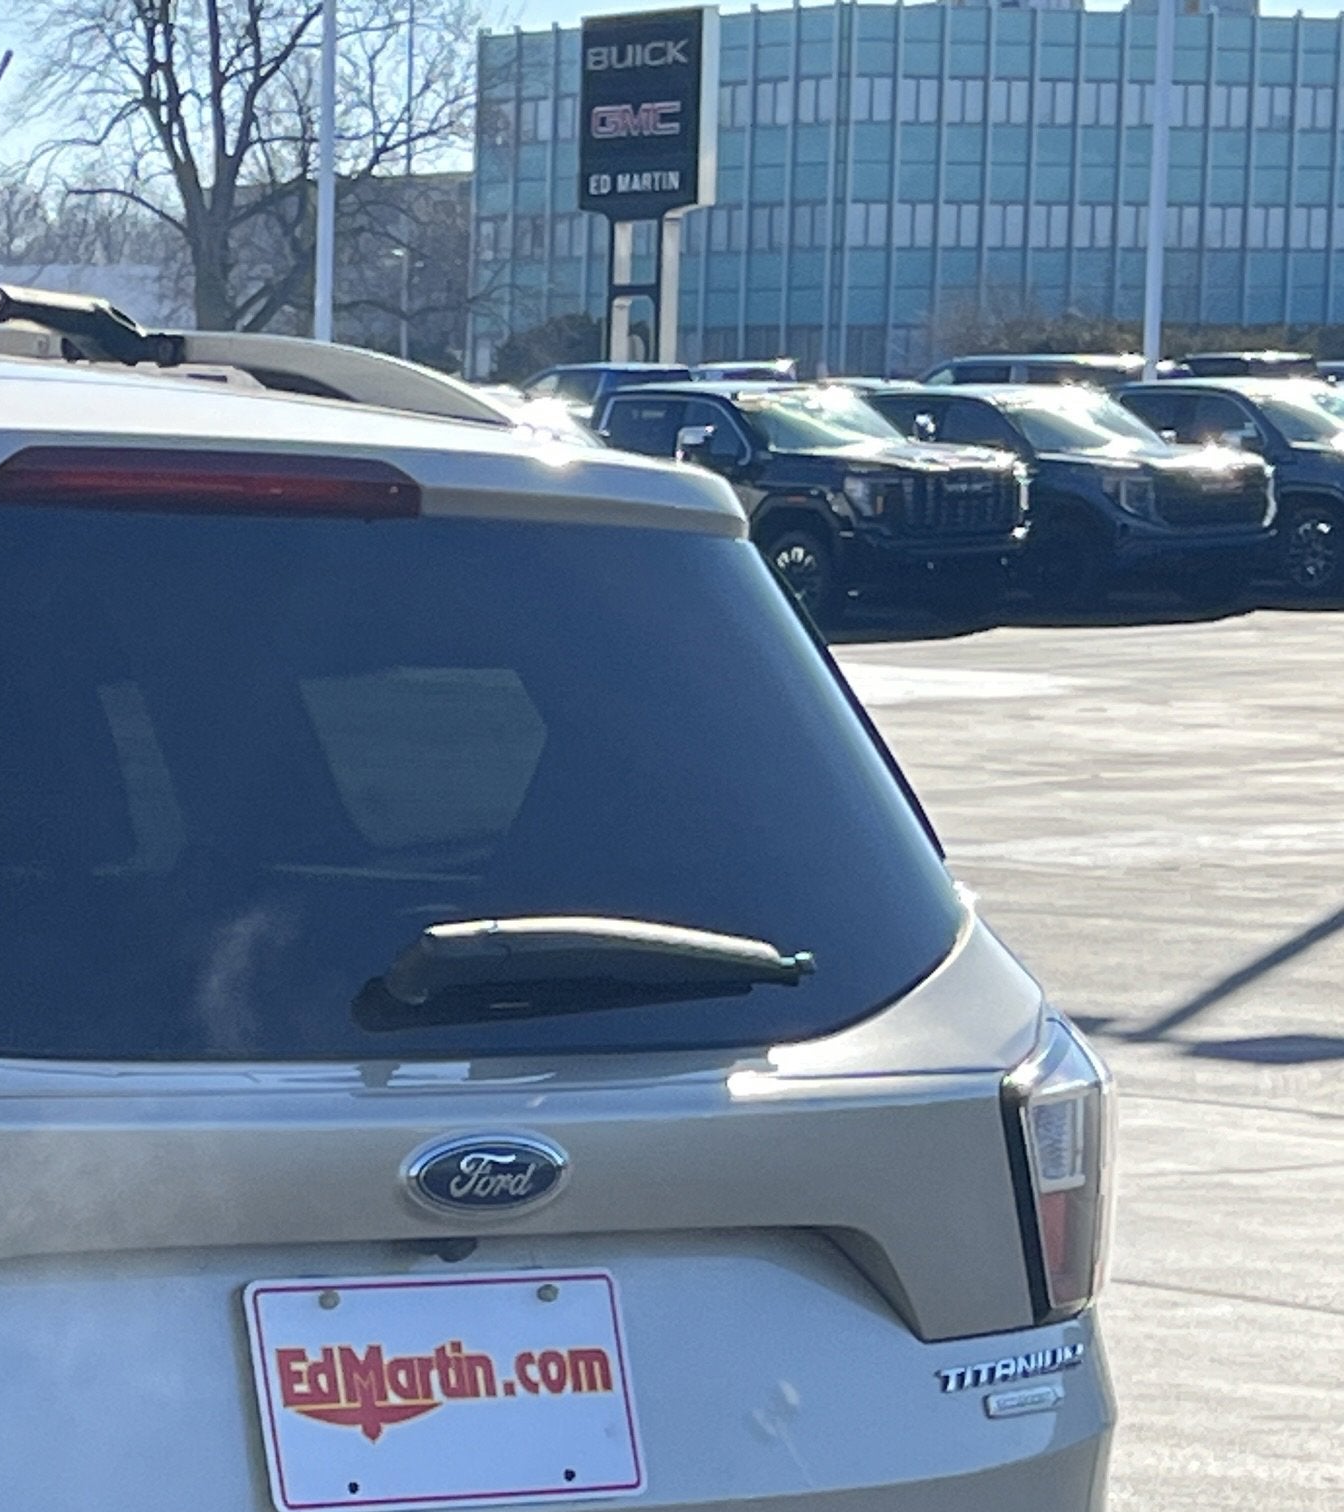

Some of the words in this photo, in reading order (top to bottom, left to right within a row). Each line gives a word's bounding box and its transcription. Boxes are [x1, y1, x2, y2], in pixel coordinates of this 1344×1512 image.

[586, 39, 688, 71] BUICK
[591, 101, 681, 139] GMC
[588, 173, 611, 195] ED
[616, 170, 680, 193] MARTIN
[449, 1153, 539, 1198] Ford
[275, 1339, 614, 1408] EdMartin.com
[938, 1342, 1085, 1393] TITANIUM
